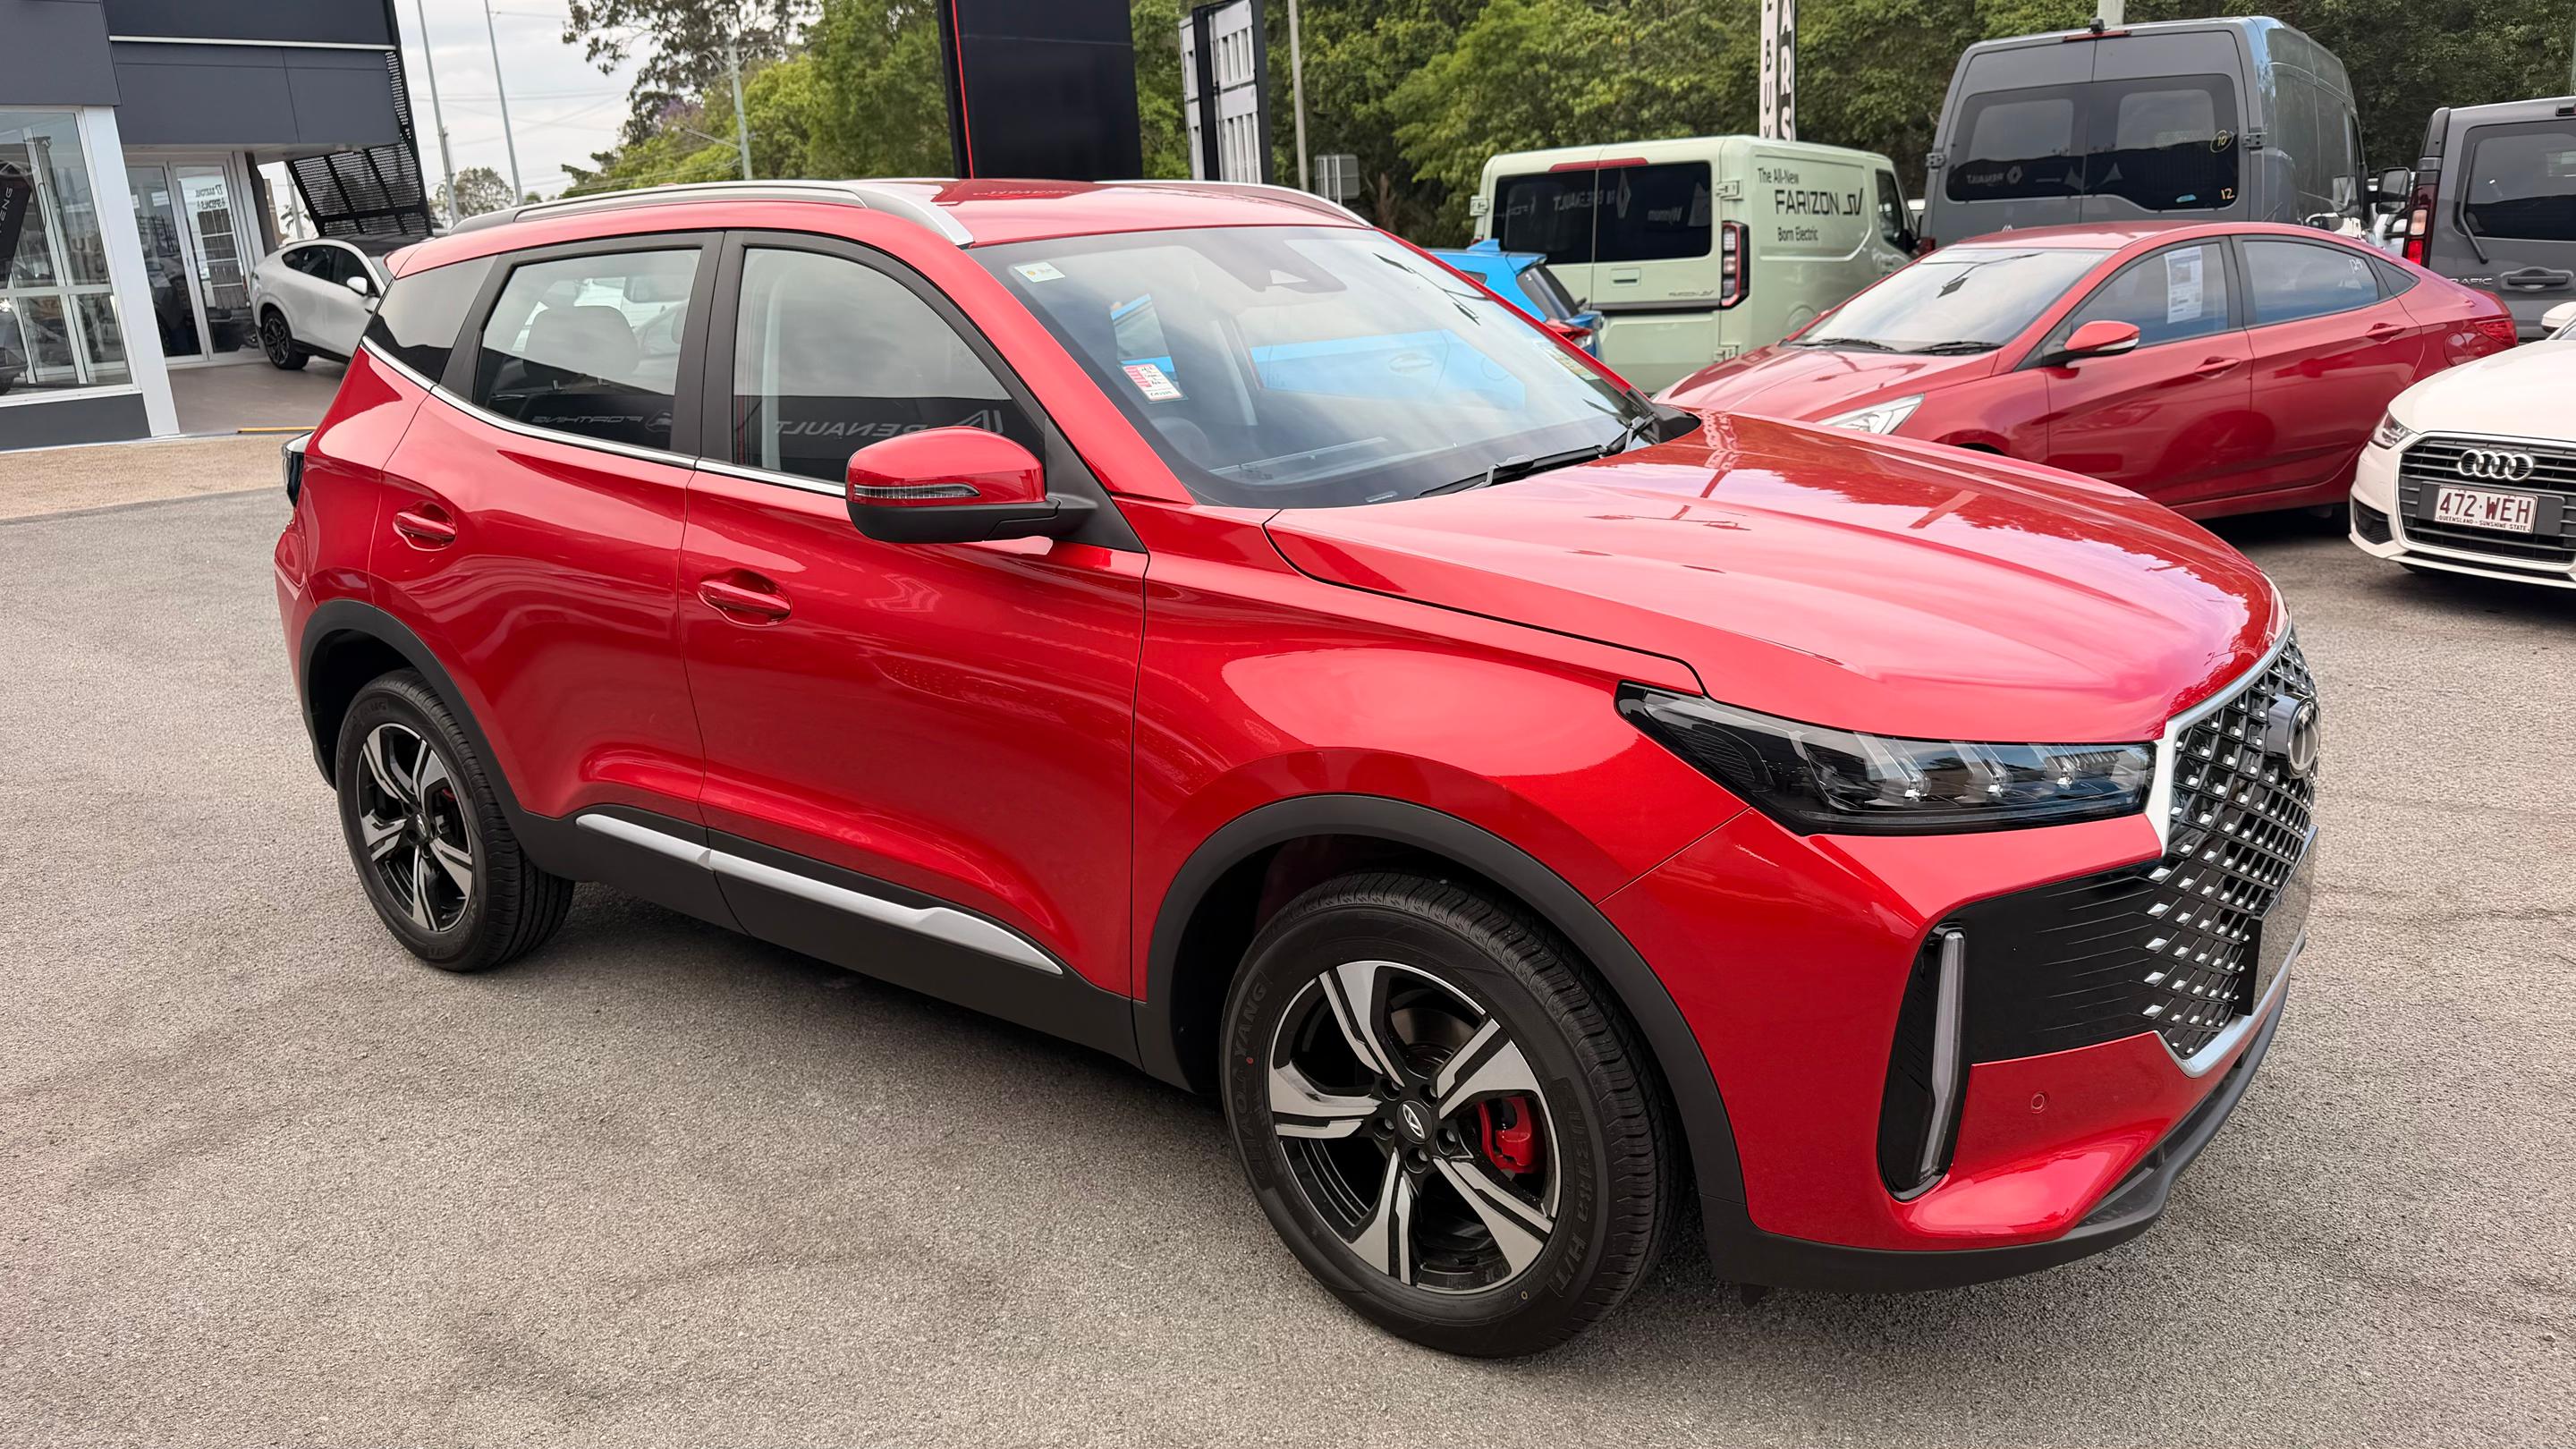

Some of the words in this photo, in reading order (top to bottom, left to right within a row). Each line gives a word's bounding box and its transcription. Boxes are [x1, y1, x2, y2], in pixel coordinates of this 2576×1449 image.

[1757, 167, 1772, 183] The
[2221, 188, 2235, 199] 12
[1775, 189, 1840, 216] FARIZON
[1777, 226, 1794, 242] Born
[1795, 225, 1818, 242] Electric
[2438, 514, 2474, 525] QUEENSLAND
[2479, 520, 2507, 530] SUNSHINE
[2509, 523, 2527, 532] STATE
